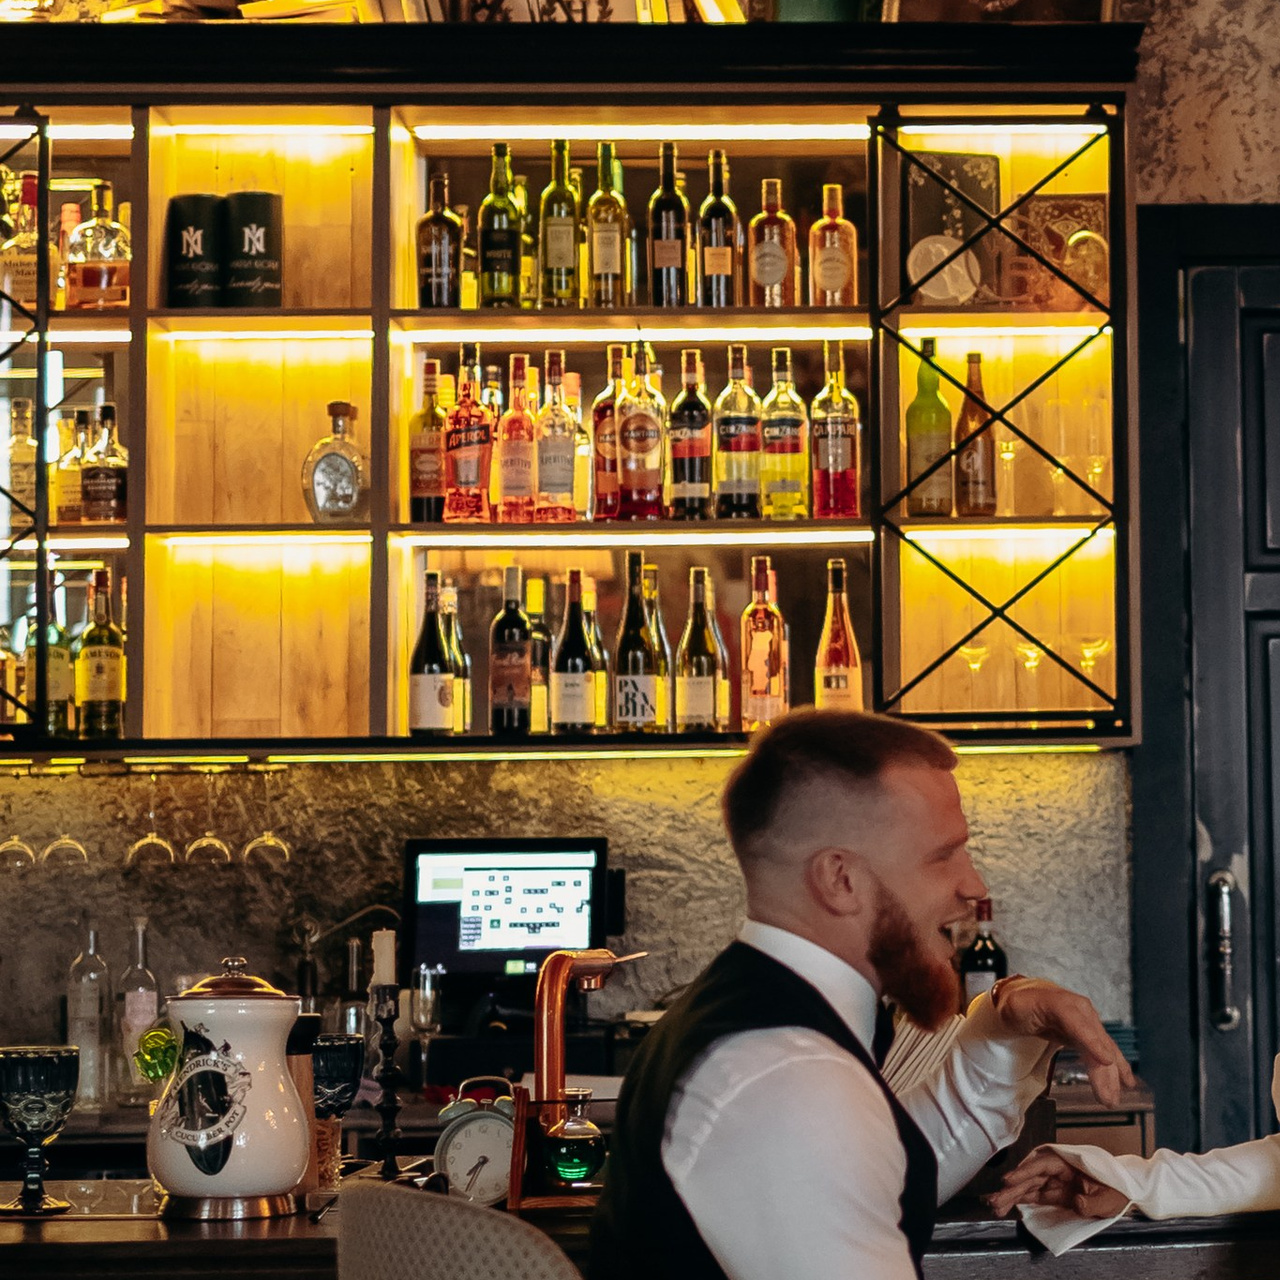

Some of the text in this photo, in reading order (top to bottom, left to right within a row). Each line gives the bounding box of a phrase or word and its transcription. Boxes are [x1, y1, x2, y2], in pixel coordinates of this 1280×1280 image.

[450, 429, 487, 446] APEROL
[623, 429, 660, 439] MARTINI
[814, 423, 856, 436] CAMPARI
[173, 1057, 231, 1091] HENDRICK'S
[175, 1109, 240, 1142] CUCUBER POT
